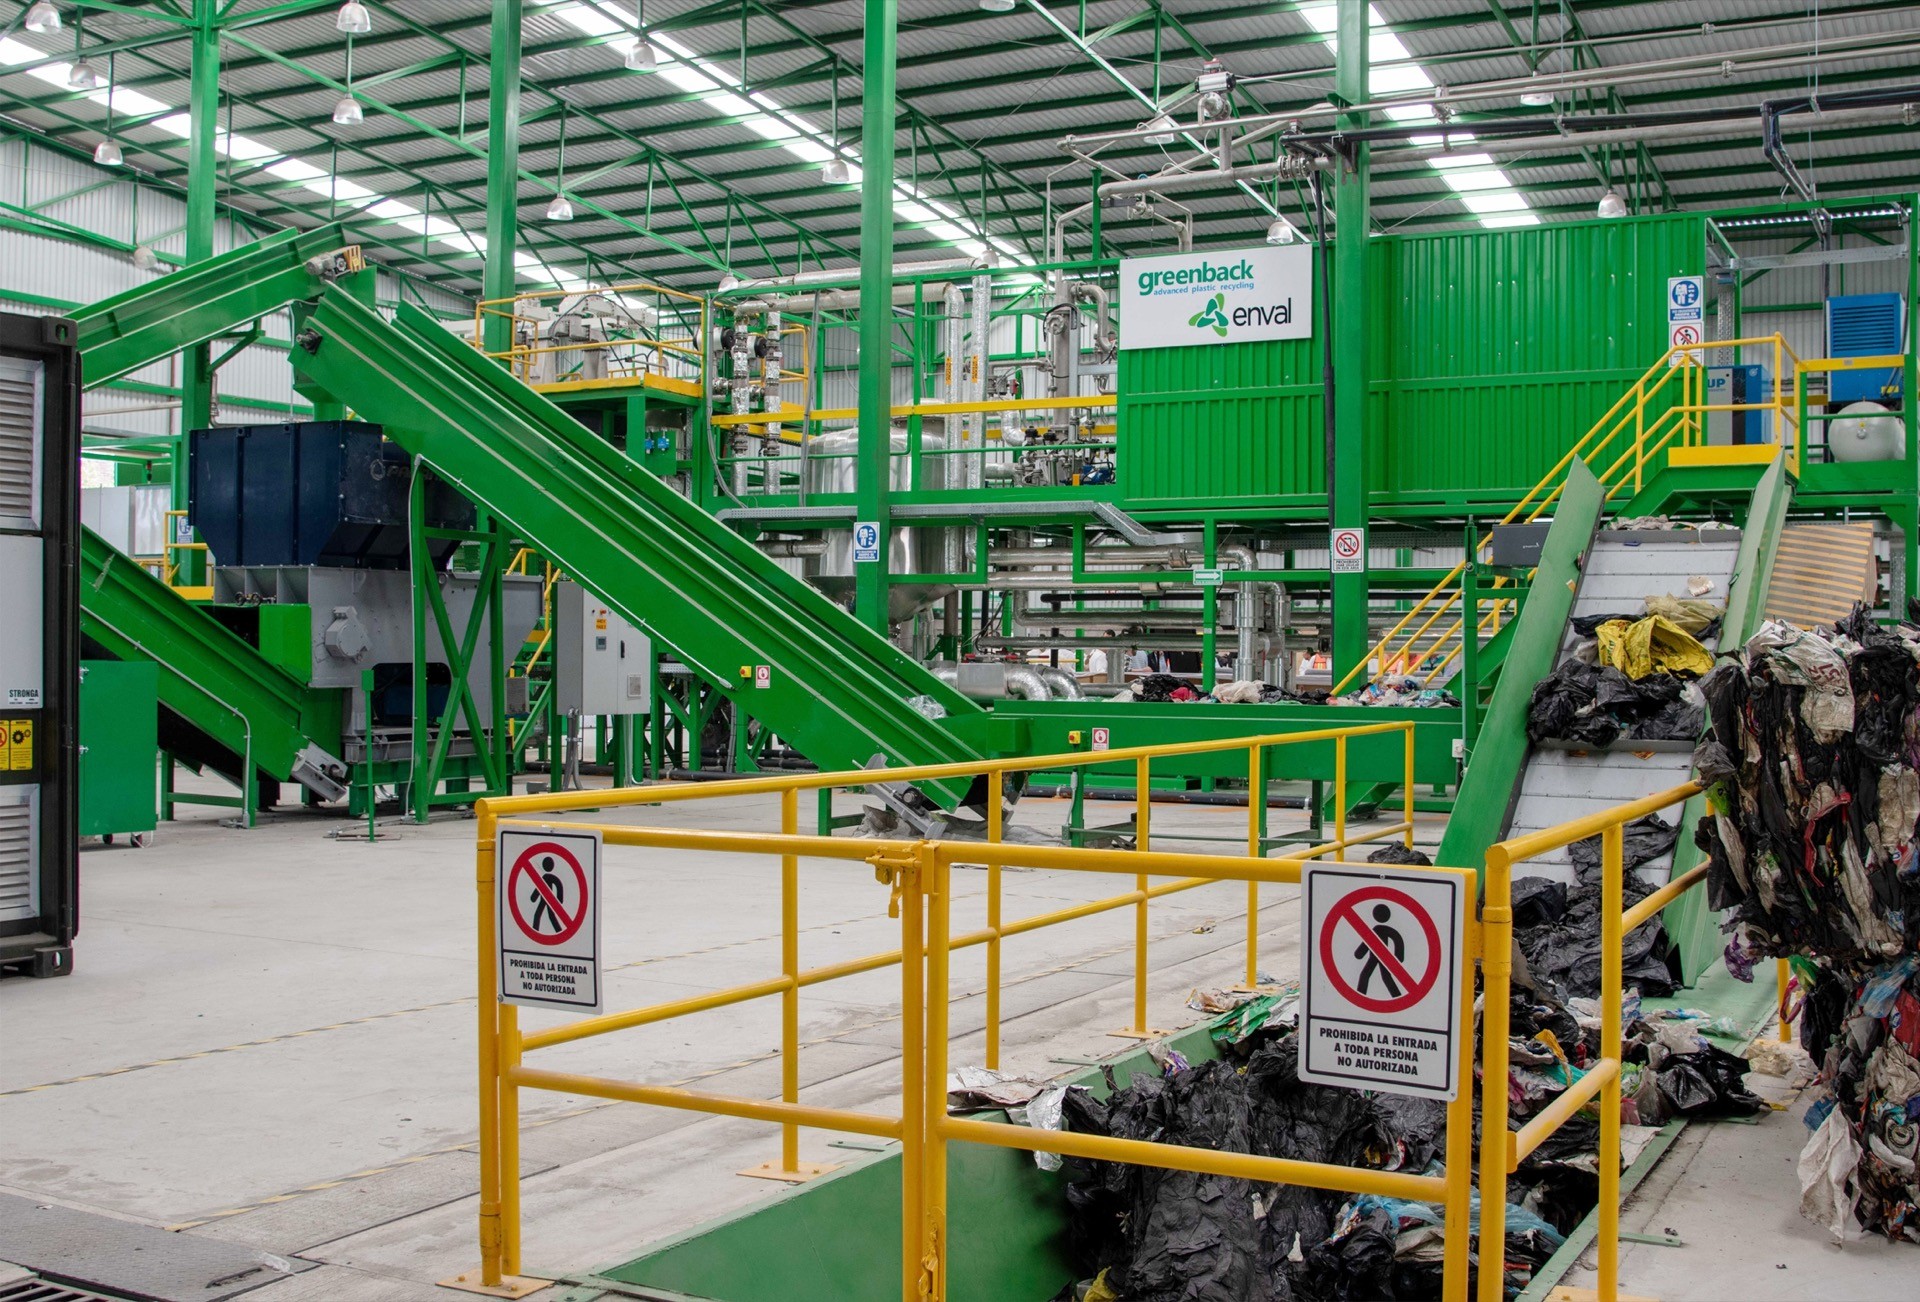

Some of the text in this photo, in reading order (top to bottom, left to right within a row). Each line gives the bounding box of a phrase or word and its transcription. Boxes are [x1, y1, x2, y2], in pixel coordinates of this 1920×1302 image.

[1138, 259, 1254, 296] greenback
[1153, 281, 1254, 296] advanced plastic recycling
[1232, 297, 1292, 327] enval
[9, 689, 39, 698] STRONGA
[510, 959, 545, 970] PROHIBIDA
[557, 964, 588, 975] ENTRADA
[520, 971, 576, 984] A TODA PERSONA
[522, 981, 576, 995] NO AUTORIZADA
[1320, 1027, 1438, 1051] PROHIBIDA LA ENTRADA
[1334, 1042, 1419, 1062] A TODA PERSONA
[1337, 1056, 1418, 1076] NO AUTORIZADA
